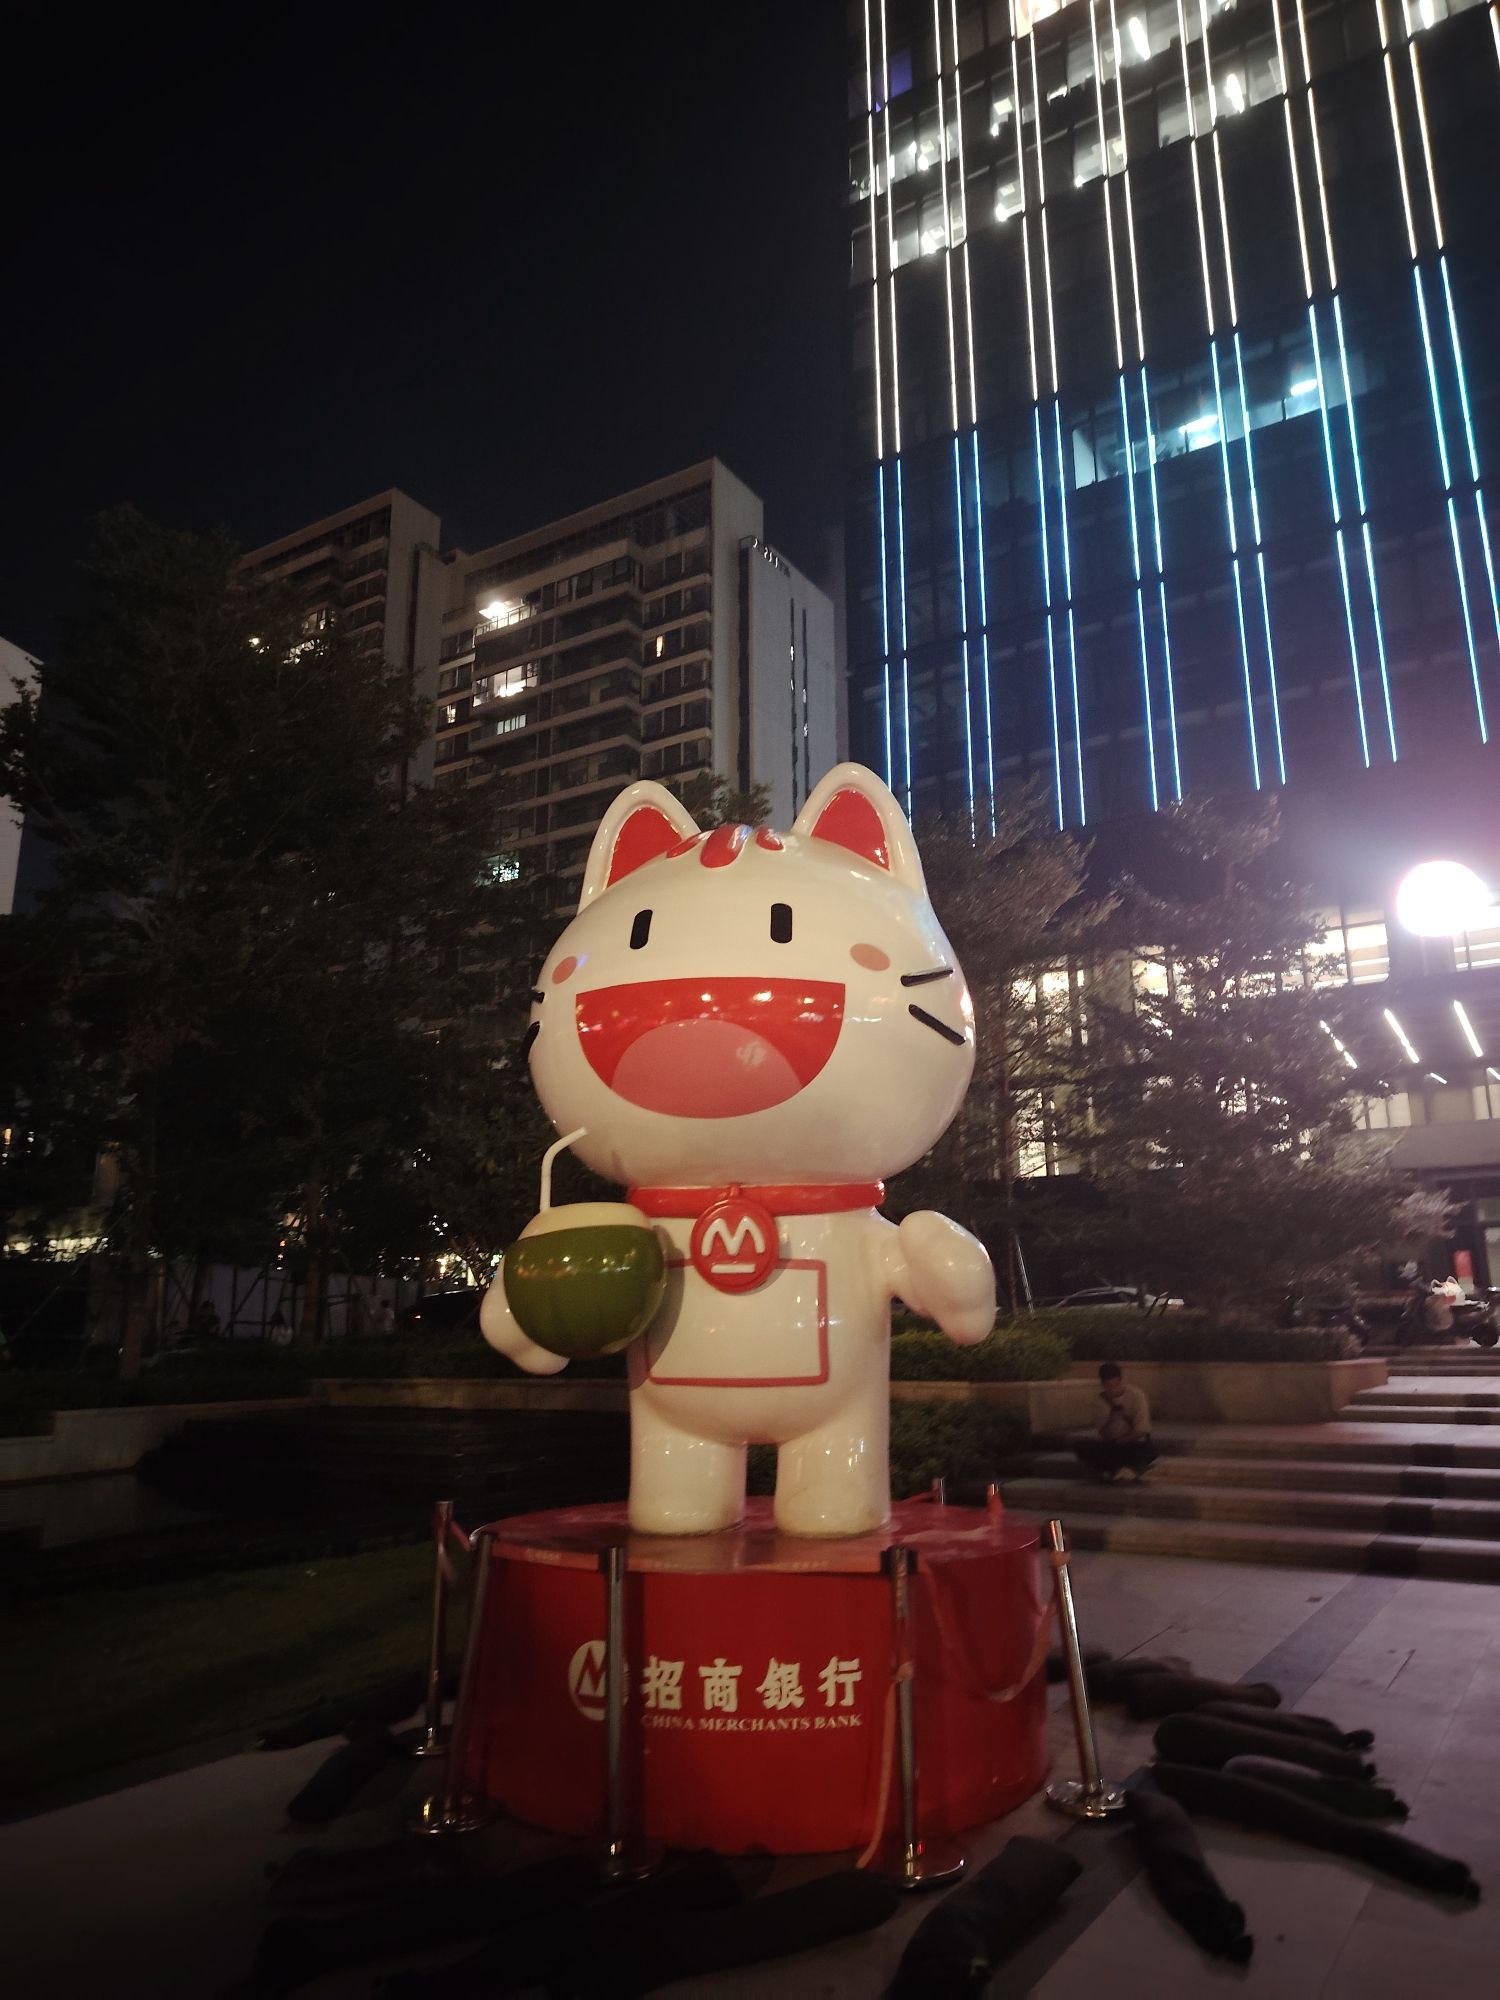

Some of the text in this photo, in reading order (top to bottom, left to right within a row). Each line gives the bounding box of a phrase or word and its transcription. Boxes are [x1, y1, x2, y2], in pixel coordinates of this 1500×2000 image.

[640, 1713, 862, 1732] CHINA MERCHANTS BANK
